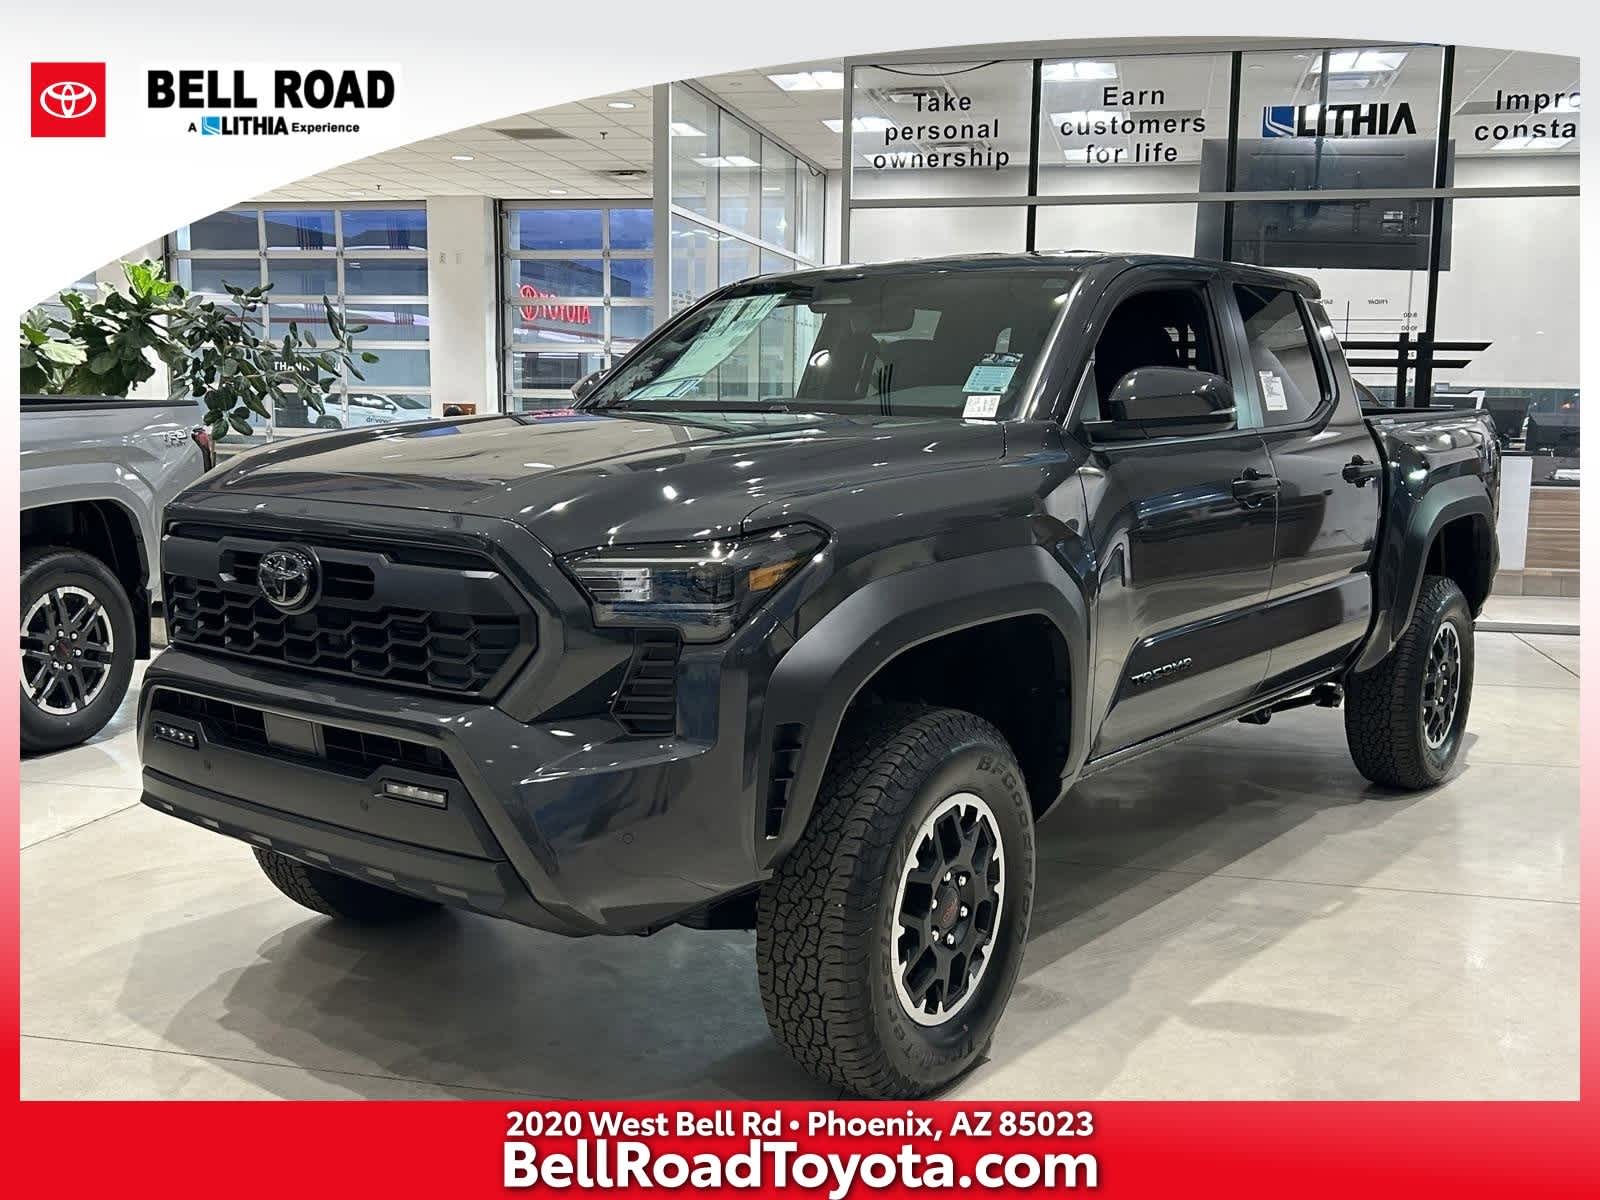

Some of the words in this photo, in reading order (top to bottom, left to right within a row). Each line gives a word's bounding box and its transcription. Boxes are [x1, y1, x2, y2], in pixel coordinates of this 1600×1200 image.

[912, 92, 972, 112] Take
[1103, 86, 1165, 107] Earn
[1060, 116, 1206, 136] customers
[1297, 102, 1417, 137] LITHIA
[1475, 118, 1577, 140] consta
[885, 119, 999, 145] personal
[873, 147, 1010, 171] ownership
[1086, 143, 1123, 164] for
[1135, 142, 1178, 163] life
